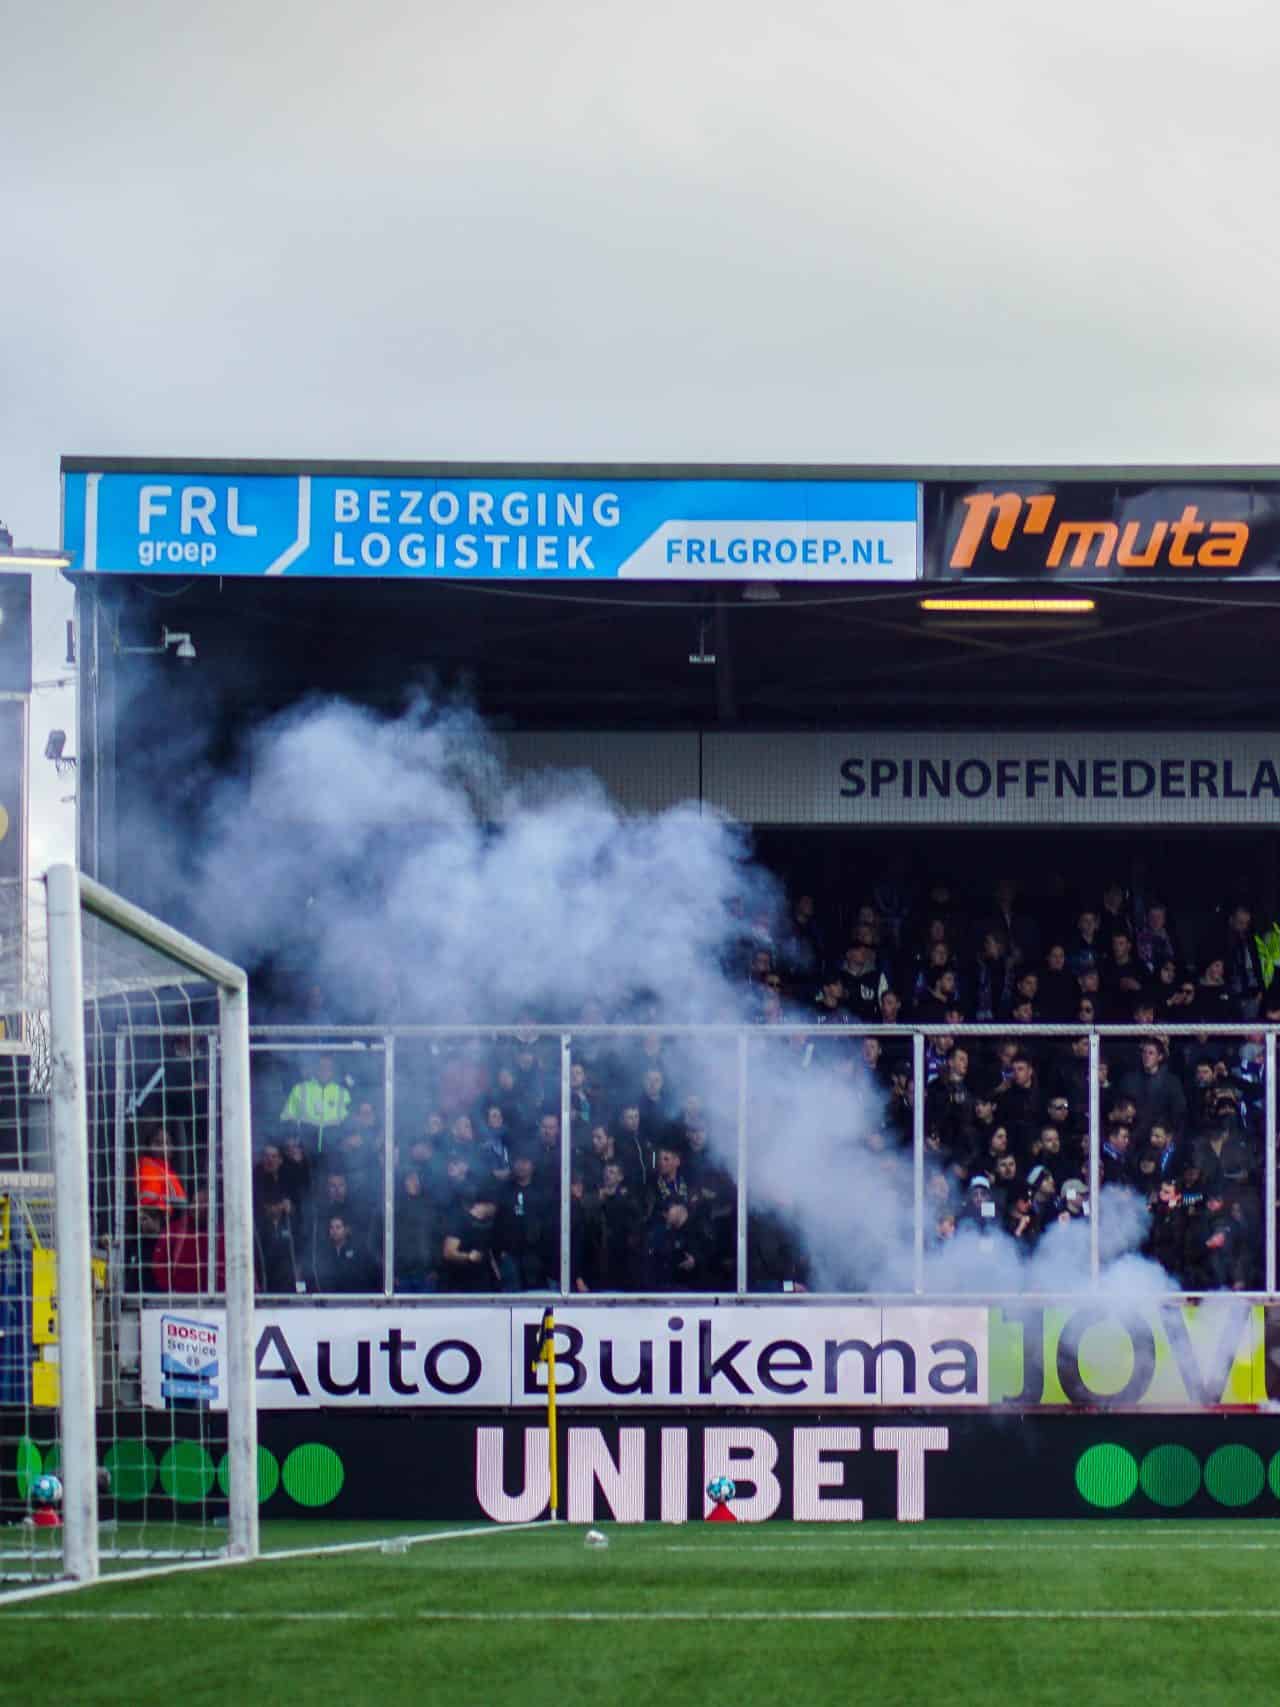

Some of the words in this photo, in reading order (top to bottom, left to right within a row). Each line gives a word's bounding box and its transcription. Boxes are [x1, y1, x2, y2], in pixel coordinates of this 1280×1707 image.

[138, 485, 257, 537] FRL
[333, 488, 620, 527] BEZORGING
[138, 540, 217, 567] groep
[333, 531, 596, 570] LOGISTIEK
[666, 538, 894, 565] FRLGROEP.NL
[1046, 505, 1250, 568] muta
[166, 1323, 218, 1345] BOSCH
[254, 1324, 482, 1397] Auto
[523, 1316, 980, 1396] Buikema
[475, 1426, 950, 1525] UNIBET
